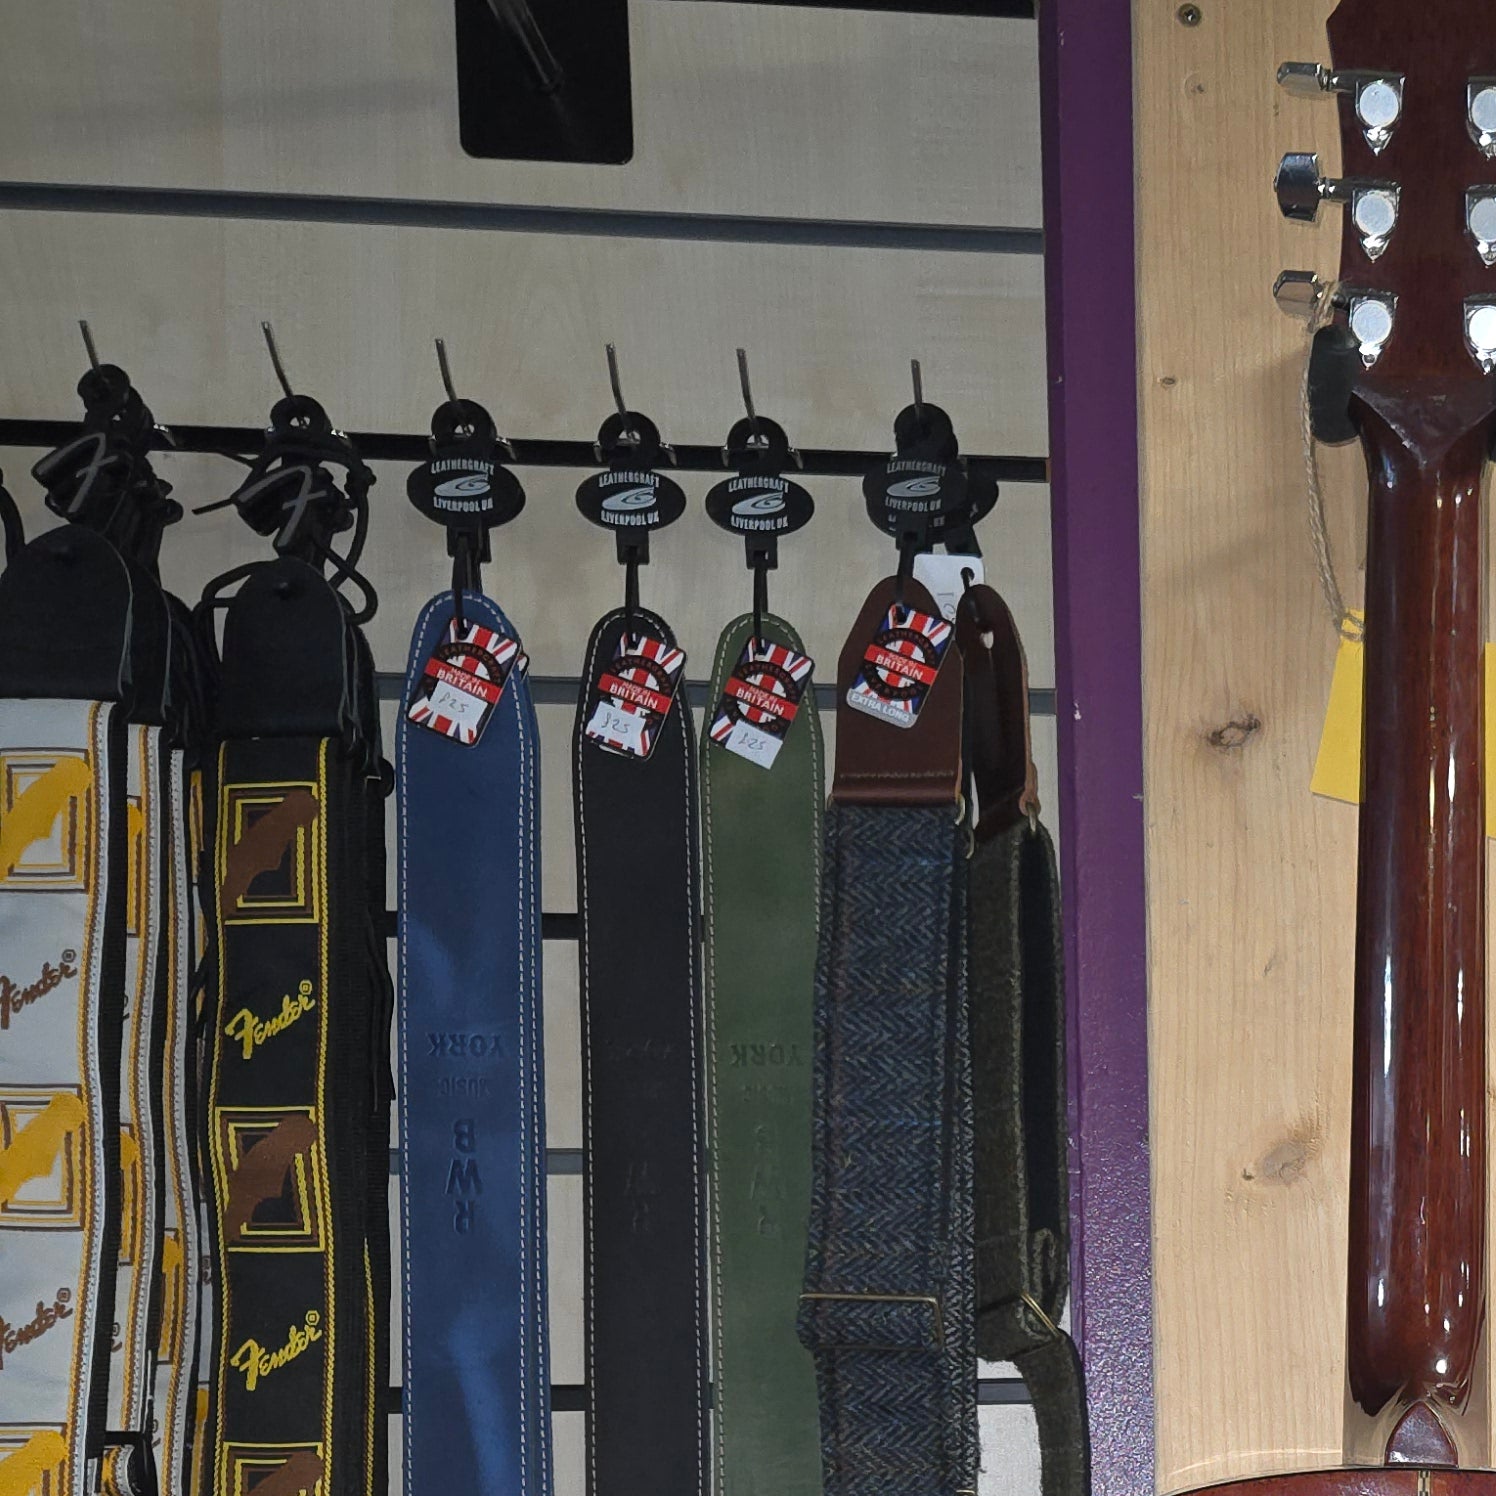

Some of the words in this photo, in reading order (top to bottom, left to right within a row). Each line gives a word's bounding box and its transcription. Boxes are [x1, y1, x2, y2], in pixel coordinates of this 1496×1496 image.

[433, 496, 480, 513] LIVERPOOL
[600, 509, 646, 526] LIVERPOOL
[647, 510, 660, 524] UK
[885, 496, 928, 513] LIVERPOOL
[730, 514, 775, 531] LIVERPOOL
[776, 515, 789, 528] UK
[875, 654, 924, 680] BRITAIN
[436, 669, 489, 698] BRITAIN
[609, 682, 658, 709] BRITAIN
[736, 687, 785, 716] BRITAIN
[851, 693, 881, 711] EXTRA
[882, 704, 911, 723] LONG
[225, 993, 315, 1060] Fender
[428, 1032, 506, 1058] YORK
[730, 1043, 803, 1069] YORK
[0, 1300, 74, 1371] ender
[229, 1322, 323, 1391] Fender
